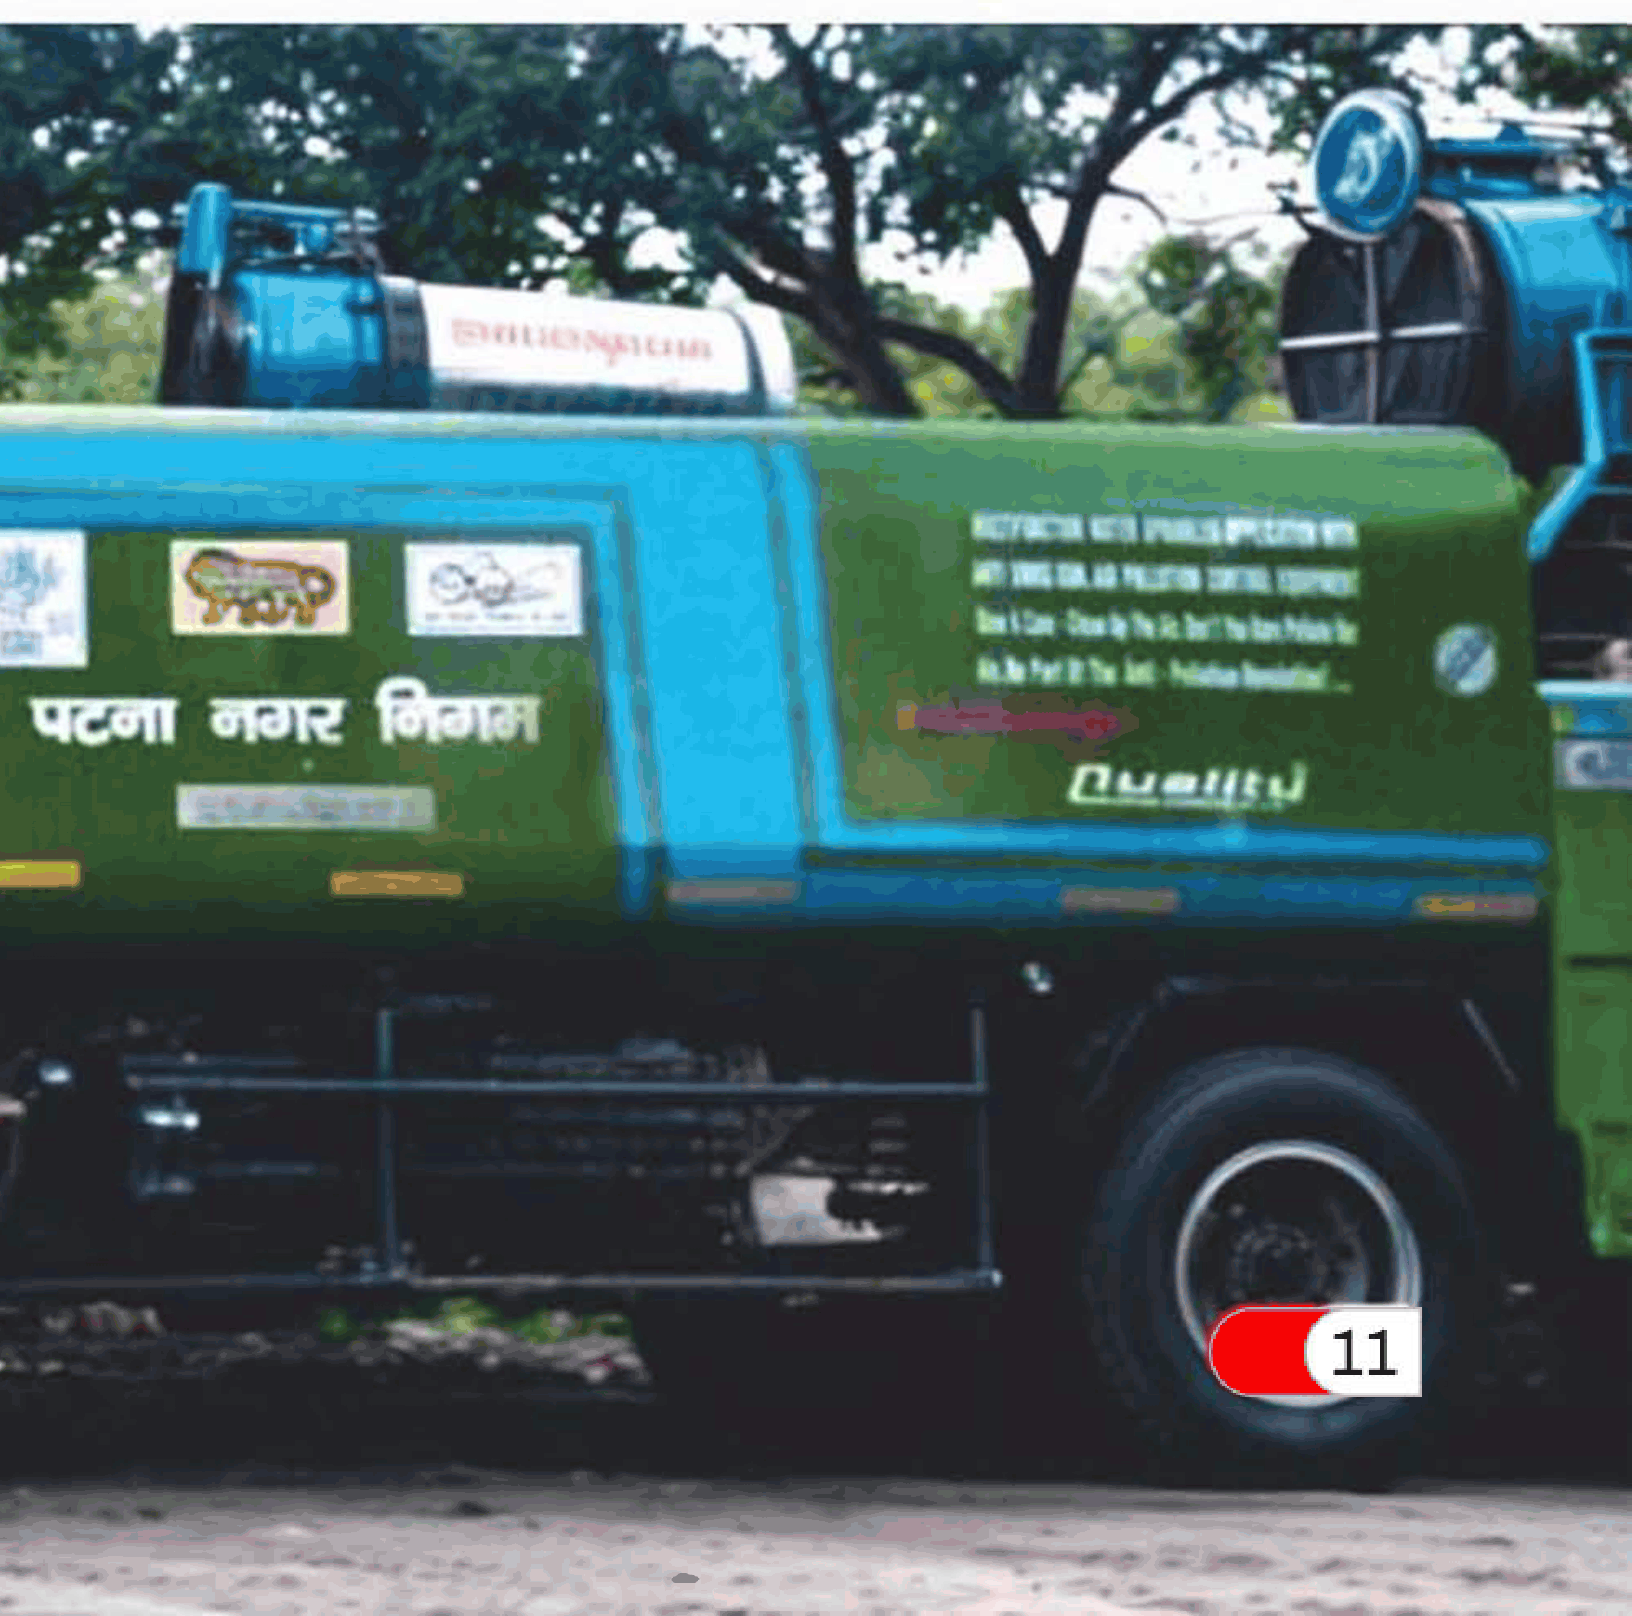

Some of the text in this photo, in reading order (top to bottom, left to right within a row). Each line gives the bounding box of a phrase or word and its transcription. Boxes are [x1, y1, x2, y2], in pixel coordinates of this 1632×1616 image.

[29, 676, 539, 746] पटना नगर निगम
